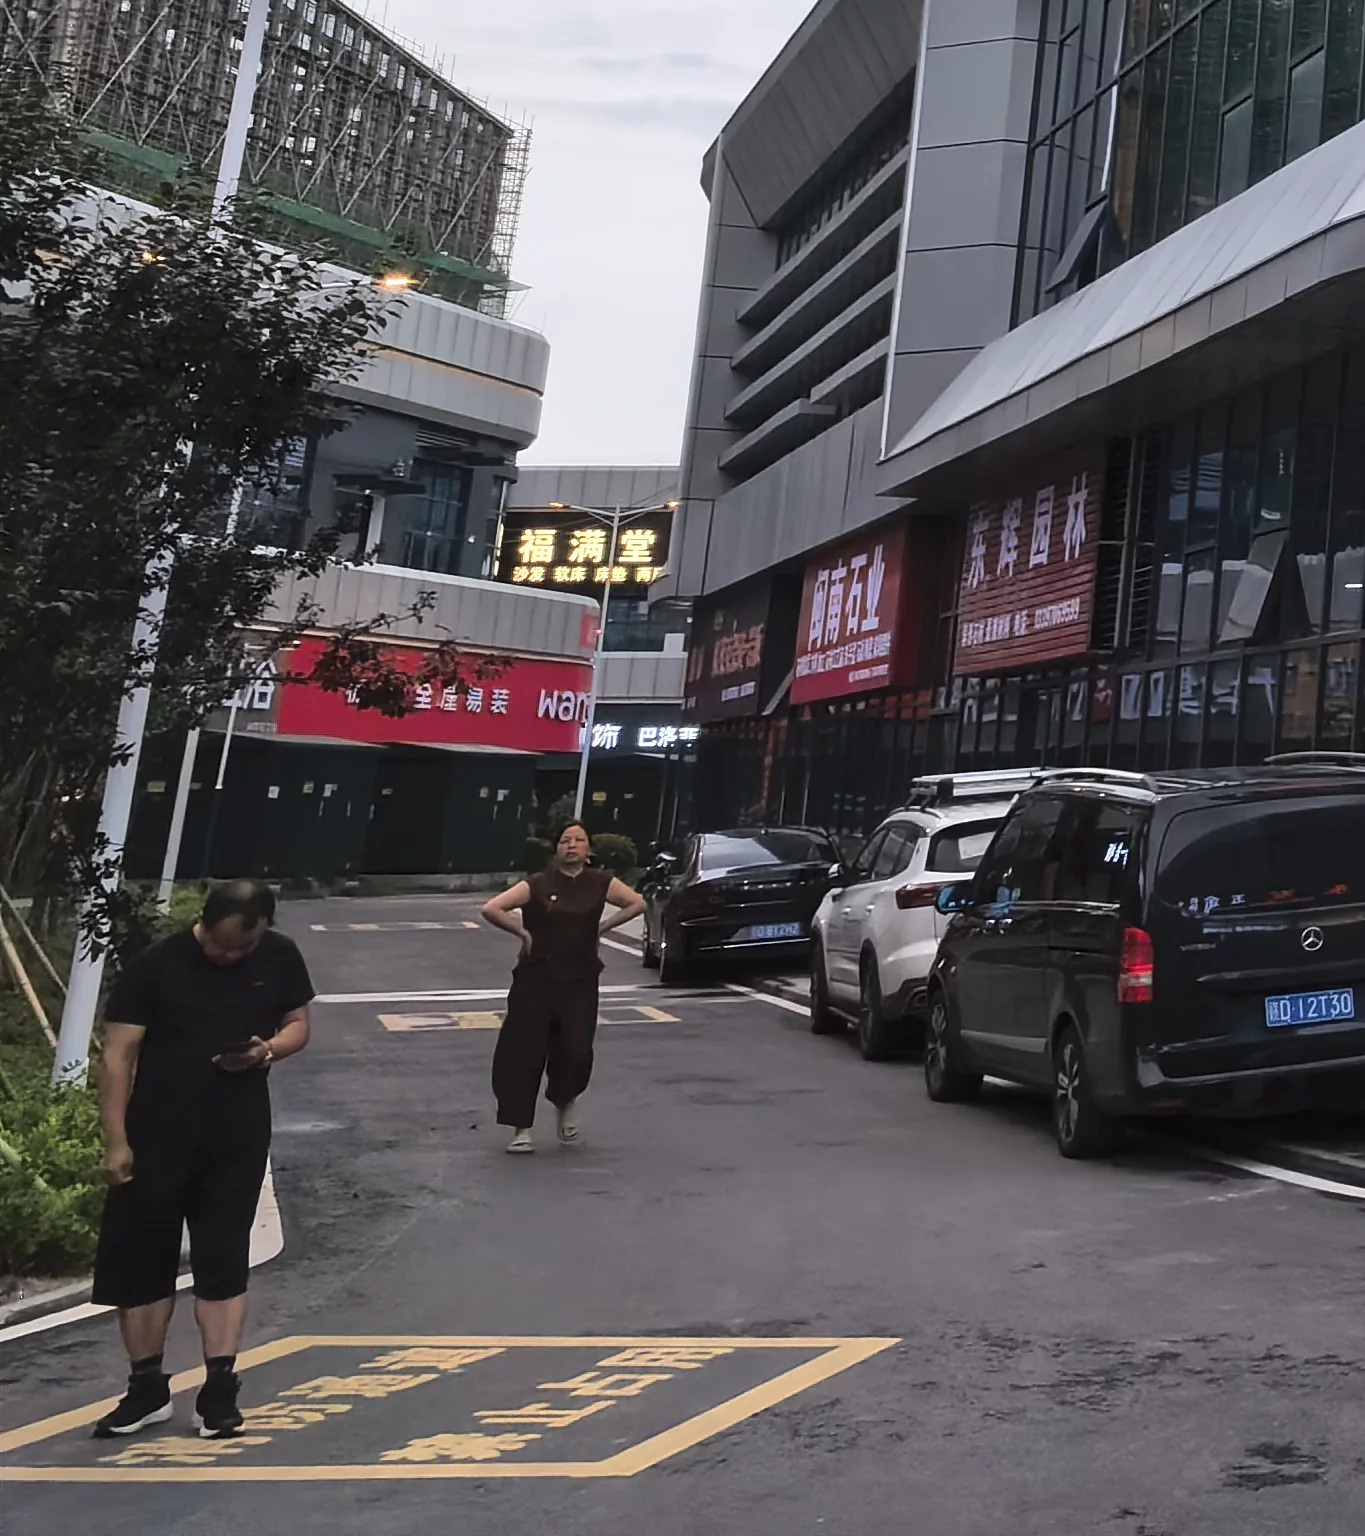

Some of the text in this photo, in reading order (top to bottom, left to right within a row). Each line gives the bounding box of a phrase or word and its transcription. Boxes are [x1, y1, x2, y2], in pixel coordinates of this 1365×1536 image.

[512, 566, 545, 583] 沙发
[553, 566, 587, 583] 软床
[594, 566, 627, 583] 床垫
[518, 529, 657, 563] 福满堂
[807, 544, 886, 652] 闽南石业
[380, 1346, 736, 1463] 禁止占用
